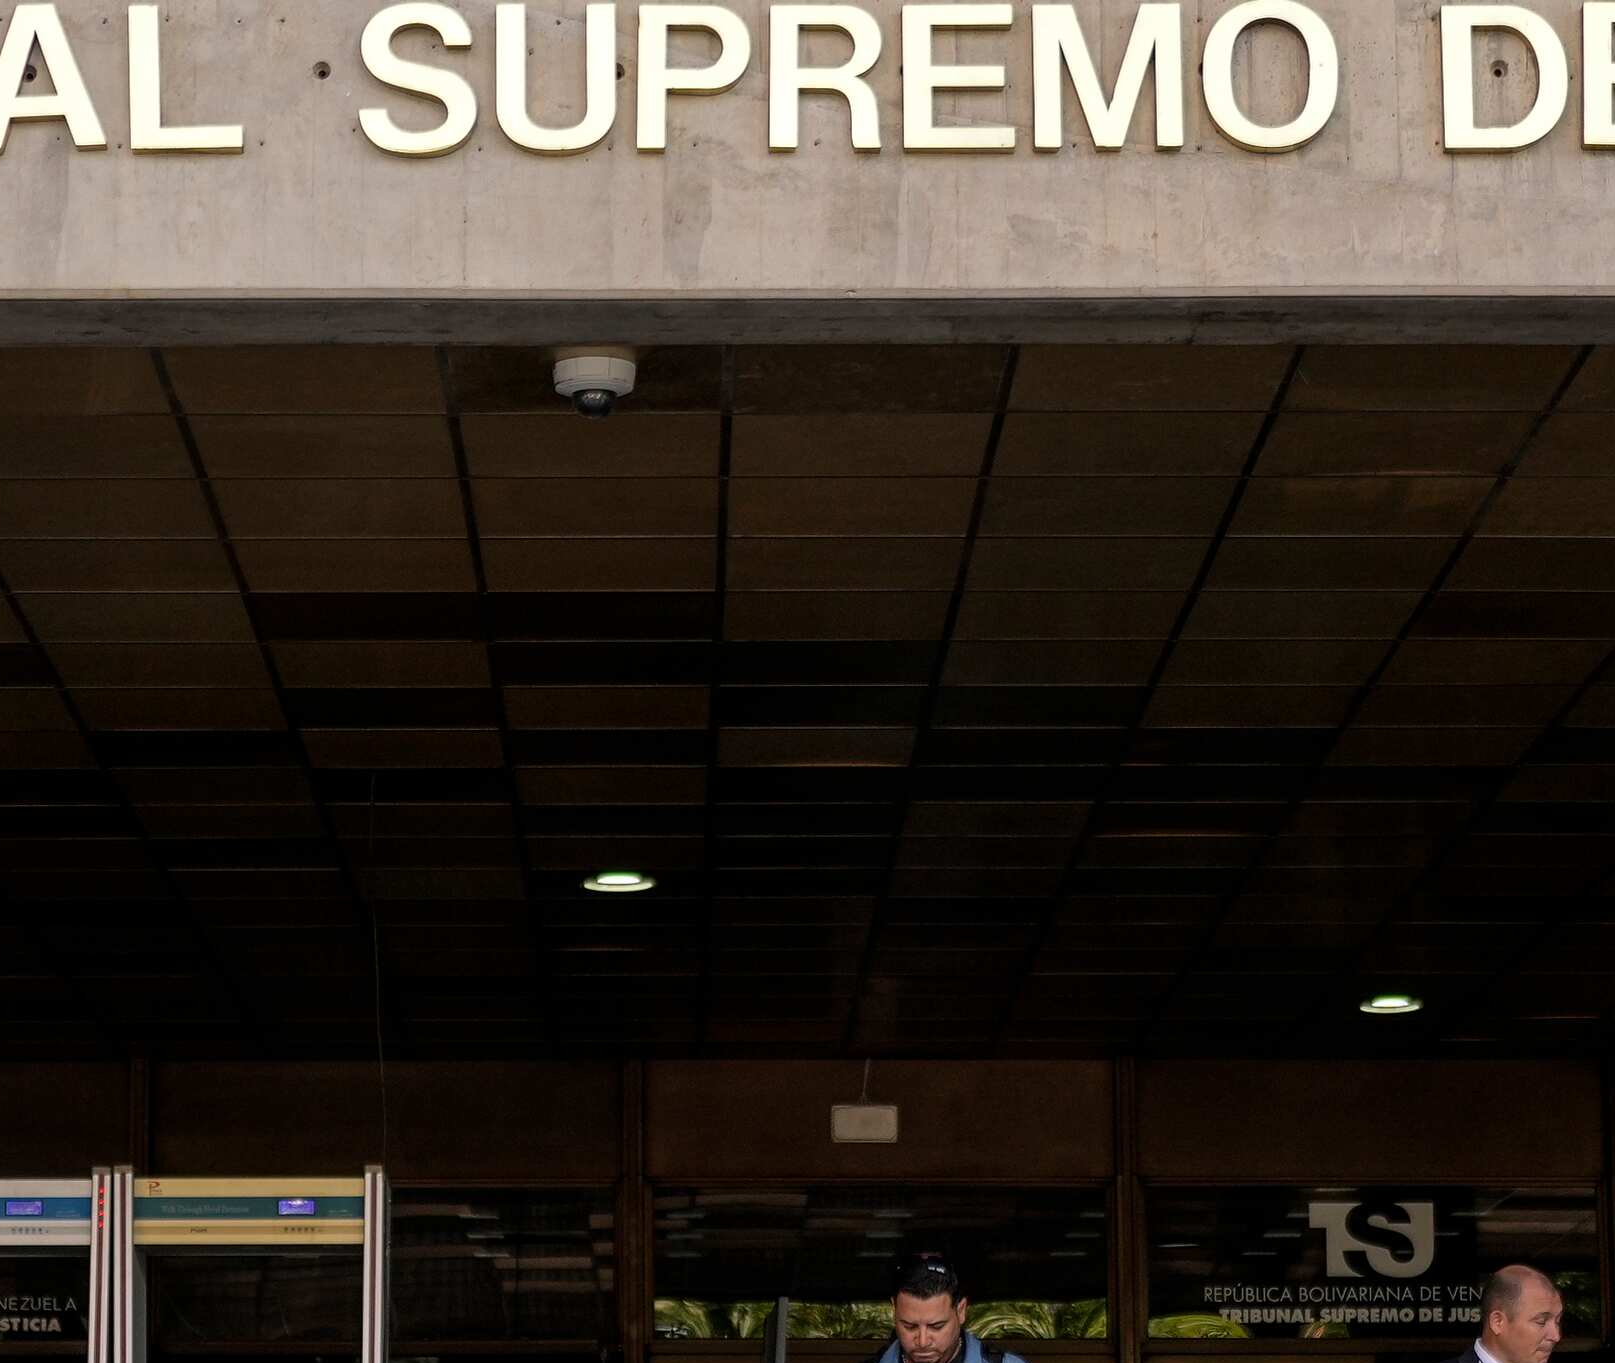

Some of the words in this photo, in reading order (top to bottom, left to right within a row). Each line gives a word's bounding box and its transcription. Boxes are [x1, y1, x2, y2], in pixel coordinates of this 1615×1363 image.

[358, 0, 1341, 157] SUPREMO
[1203, 1283, 1293, 1303] REPÚBLICA
[1299, 1286, 1414, 1302] BOLIVARIANA
[1420, 1286, 1441, 1302] DE
[1219, 1307, 1315, 1324] TRIBUNAL
[1319, 1307, 1415, 1324] SUPREMO
[1419, 1308, 1443, 1324] DE
